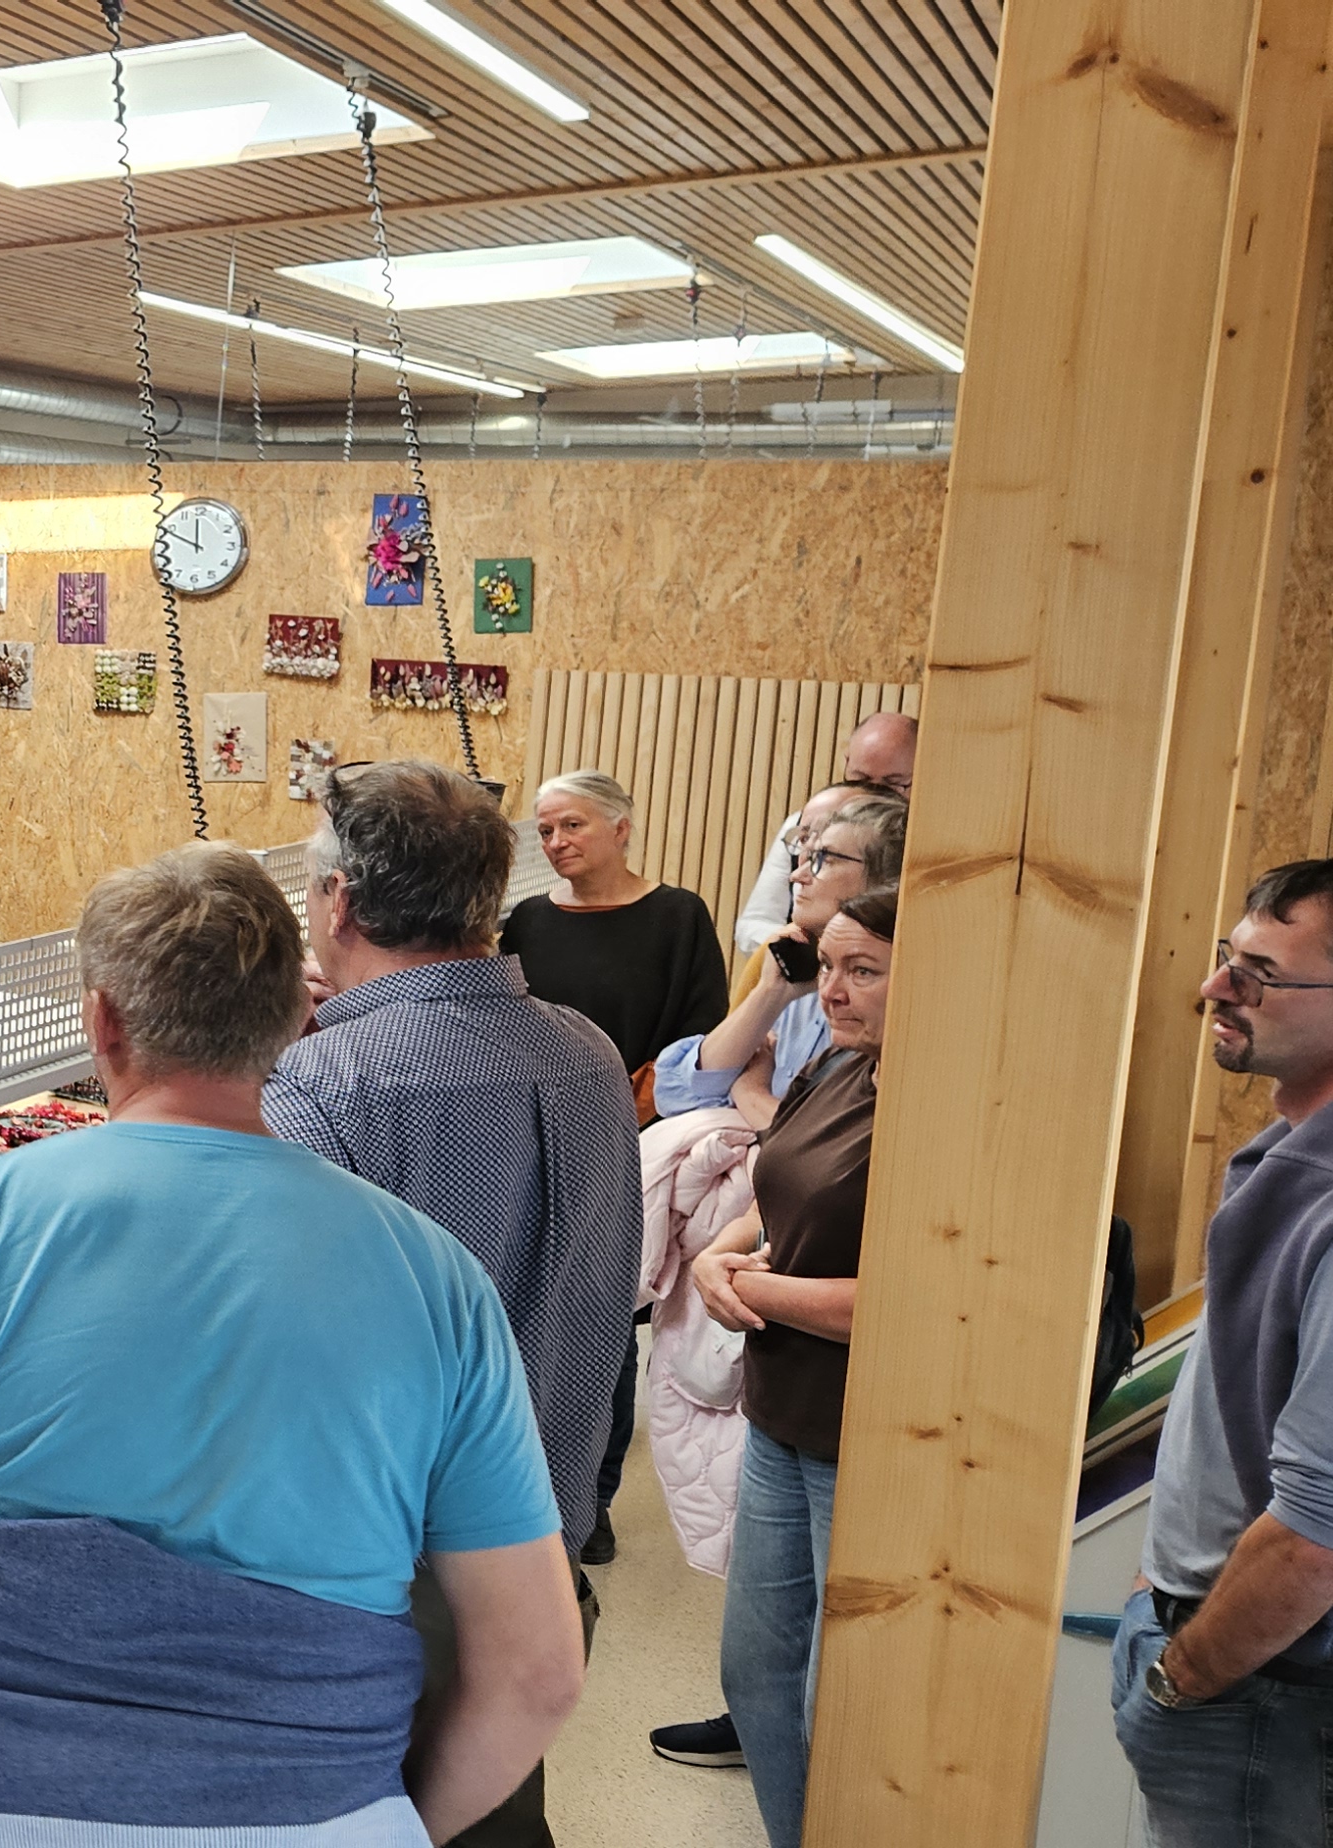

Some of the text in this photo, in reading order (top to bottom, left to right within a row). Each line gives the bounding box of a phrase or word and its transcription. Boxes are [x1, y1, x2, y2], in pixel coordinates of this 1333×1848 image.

[181, 511, 188, 520] 11
[223, 525, 233, 534] 2
[227, 542, 236, 551] 3
[220, 559, 229, 567] 4
[175, 569, 183, 578] 7
[207, 571, 216, 580] 5
[190, 574, 199, 583] 6
